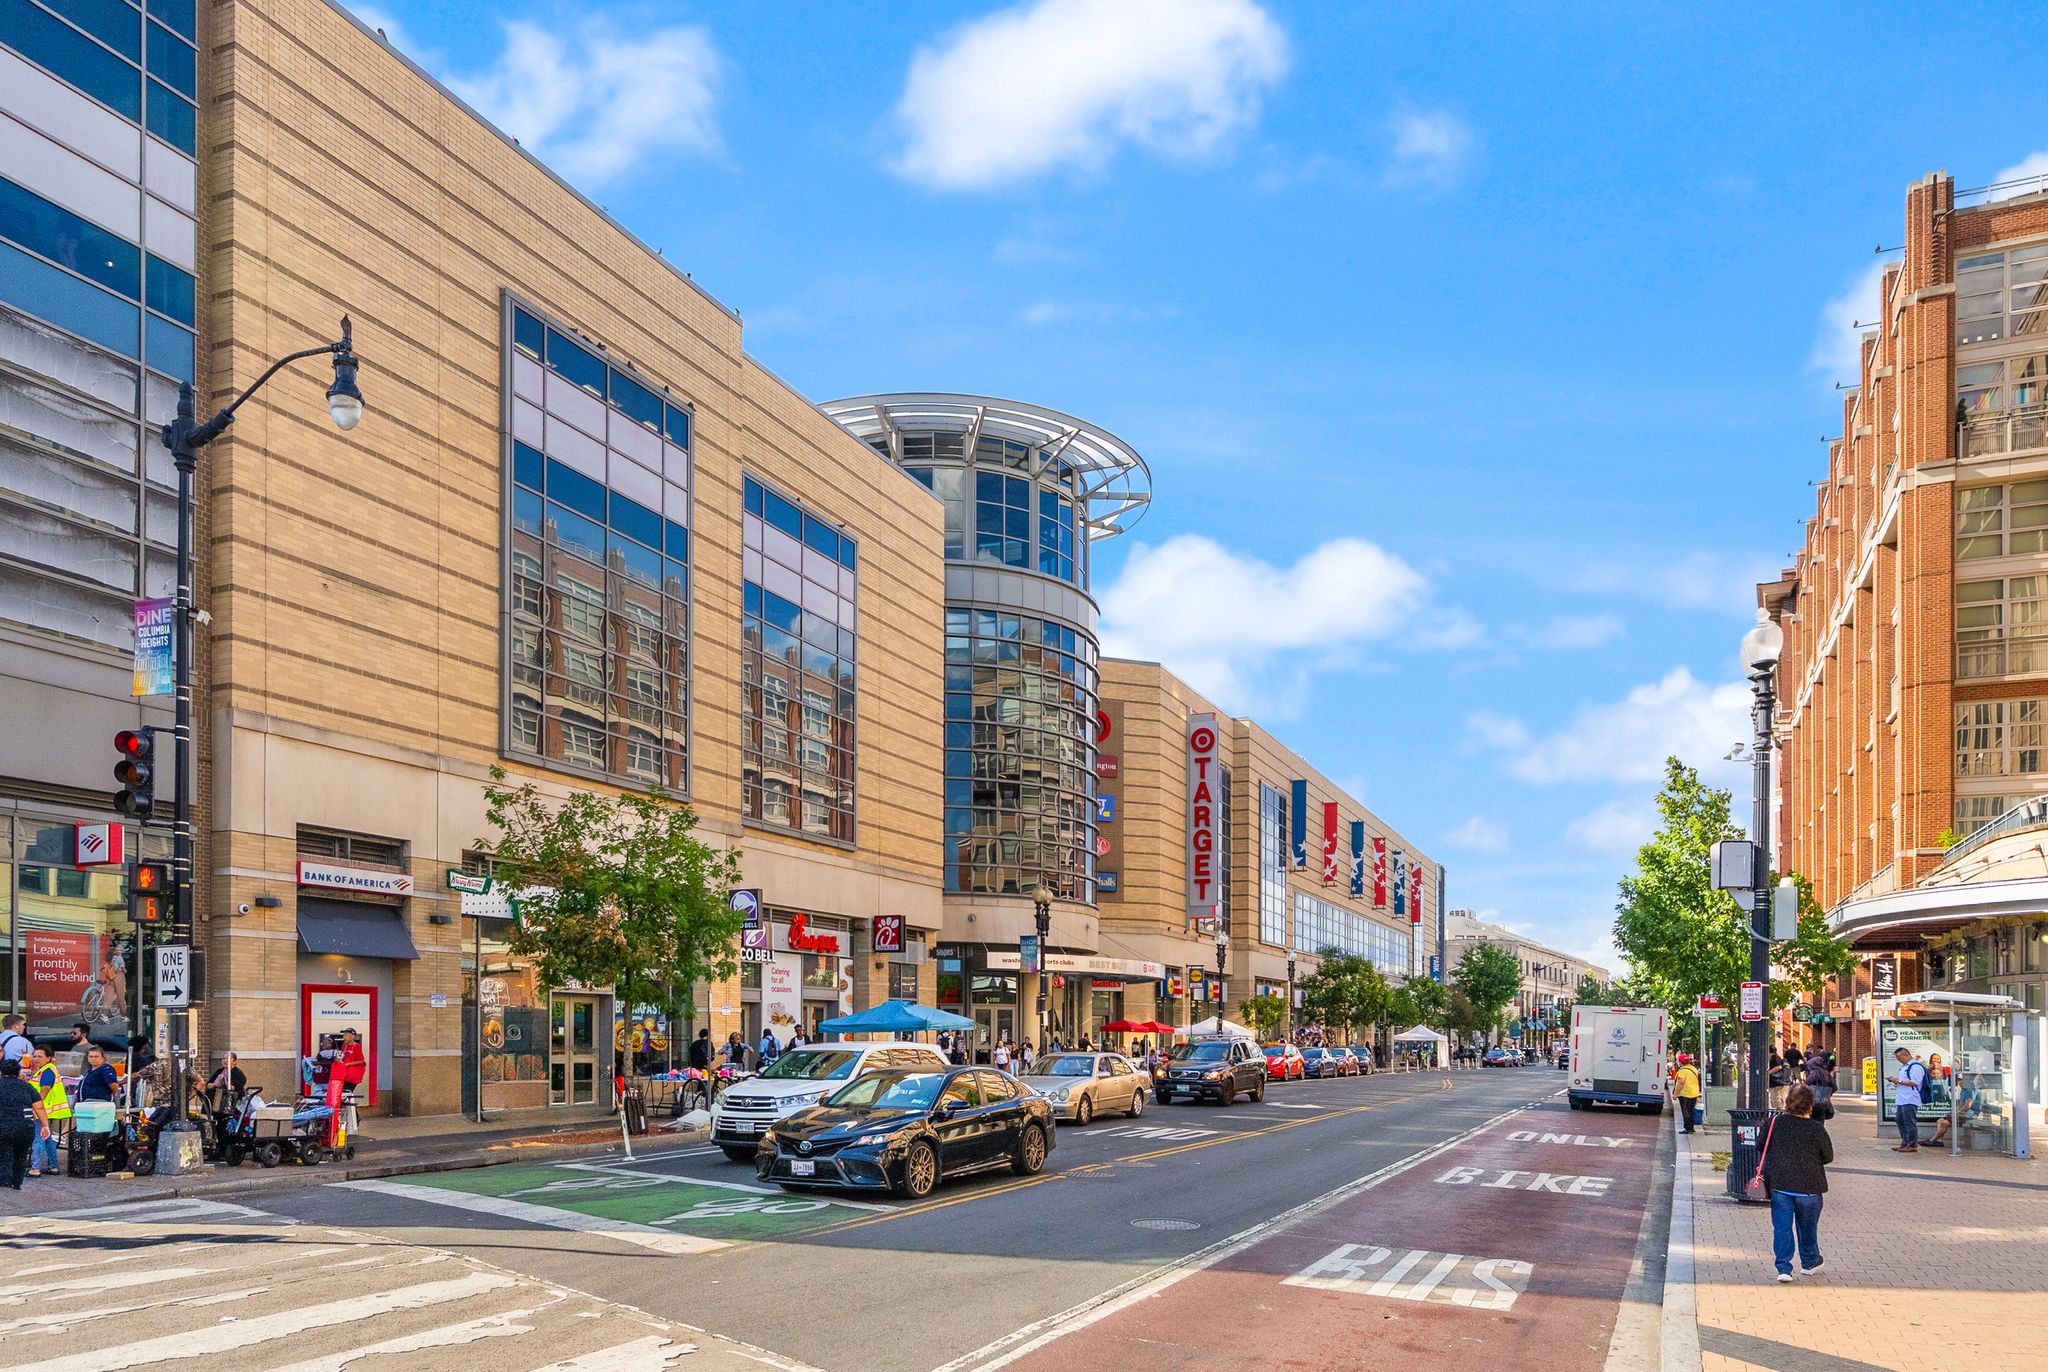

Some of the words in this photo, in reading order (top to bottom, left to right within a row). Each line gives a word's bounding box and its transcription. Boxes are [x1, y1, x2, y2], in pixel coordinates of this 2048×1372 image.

[136, 608, 171, 626] DINE
[138, 624, 170, 638] COLUMBIA
[141, 636, 168, 648] HEIGHTS
[1193, 757, 1212, 900] TARGET
[304, 871, 332, 882] BANK
[334, 876, 347, 884] OF
[348, 878, 391, 889] AMERICA
[146, 898, 157, 919] 6
[33, 944, 66, 956] Leave
[740, 948, 753, 961] CO
[754, 949, 776, 962] BELL
[33, 958, 78, 972] monthly
[162, 952, 183, 966] ONE
[1089, 960, 1110, 970] BEST
[1112, 962, 1128, 970] BUY
[1432, 956, 1440, 972] PARK
[34, 970, 57, 981] fees
[60, 971, 96, 982] behind
[162, 968, 184, 983] WAY
[771, 968, 790, 978] Catering
[616, 1000, 660, 1014] BAKFAST
[1505, 1130, 1635, 1148] ONLY
[1435, 1166, 1615, 1197] BIKE
[1280, 1243, 1534, 1312] BUS
